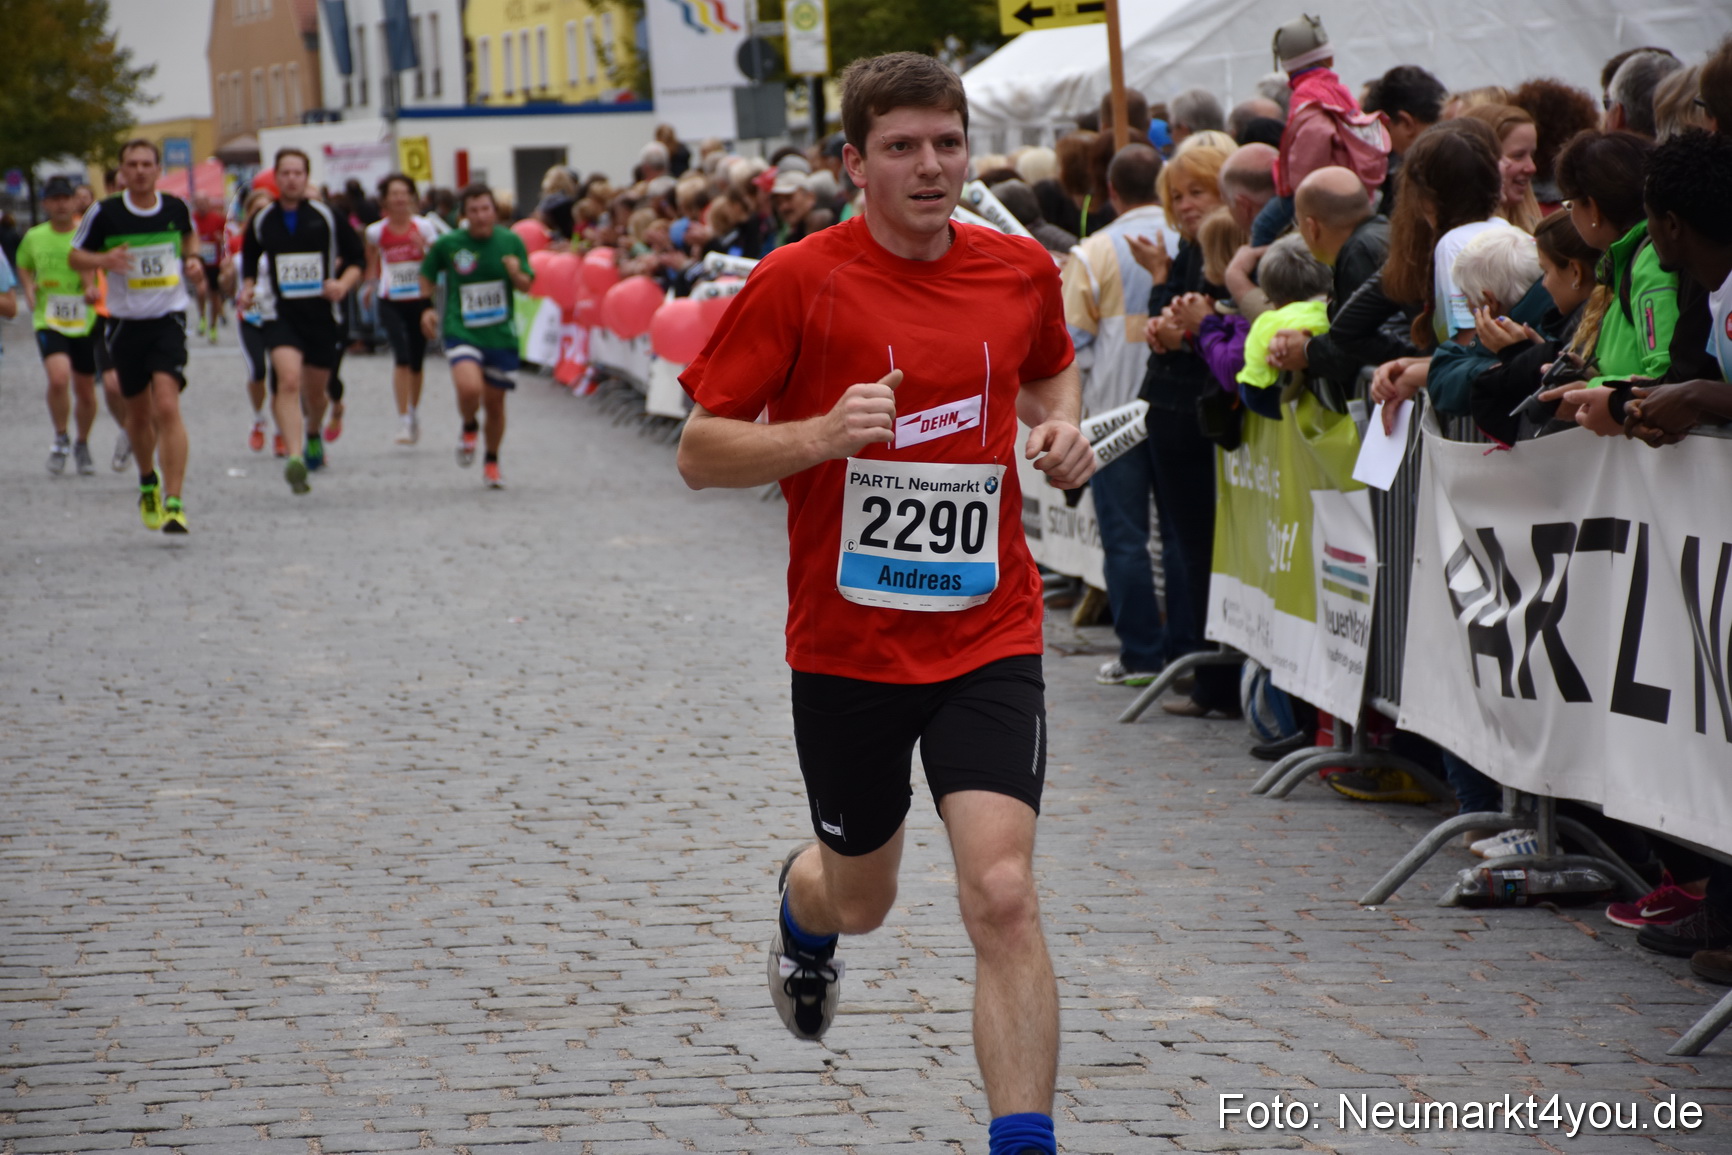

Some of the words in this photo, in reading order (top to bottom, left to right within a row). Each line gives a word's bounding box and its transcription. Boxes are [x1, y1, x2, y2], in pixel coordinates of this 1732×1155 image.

[141, 257, 163, 276] 65
[920, 411, 959, 433] DEHN
[1092, 412, 1133, 440] BMW
[1097, 430, 1135, 462] BMW
[850, 472, 904, 490] PARTL
[908, 477, 980, 493] Neumarkt
[859, 496, 989, 555] 2290
[877, 565, 962, 591] Andreas
